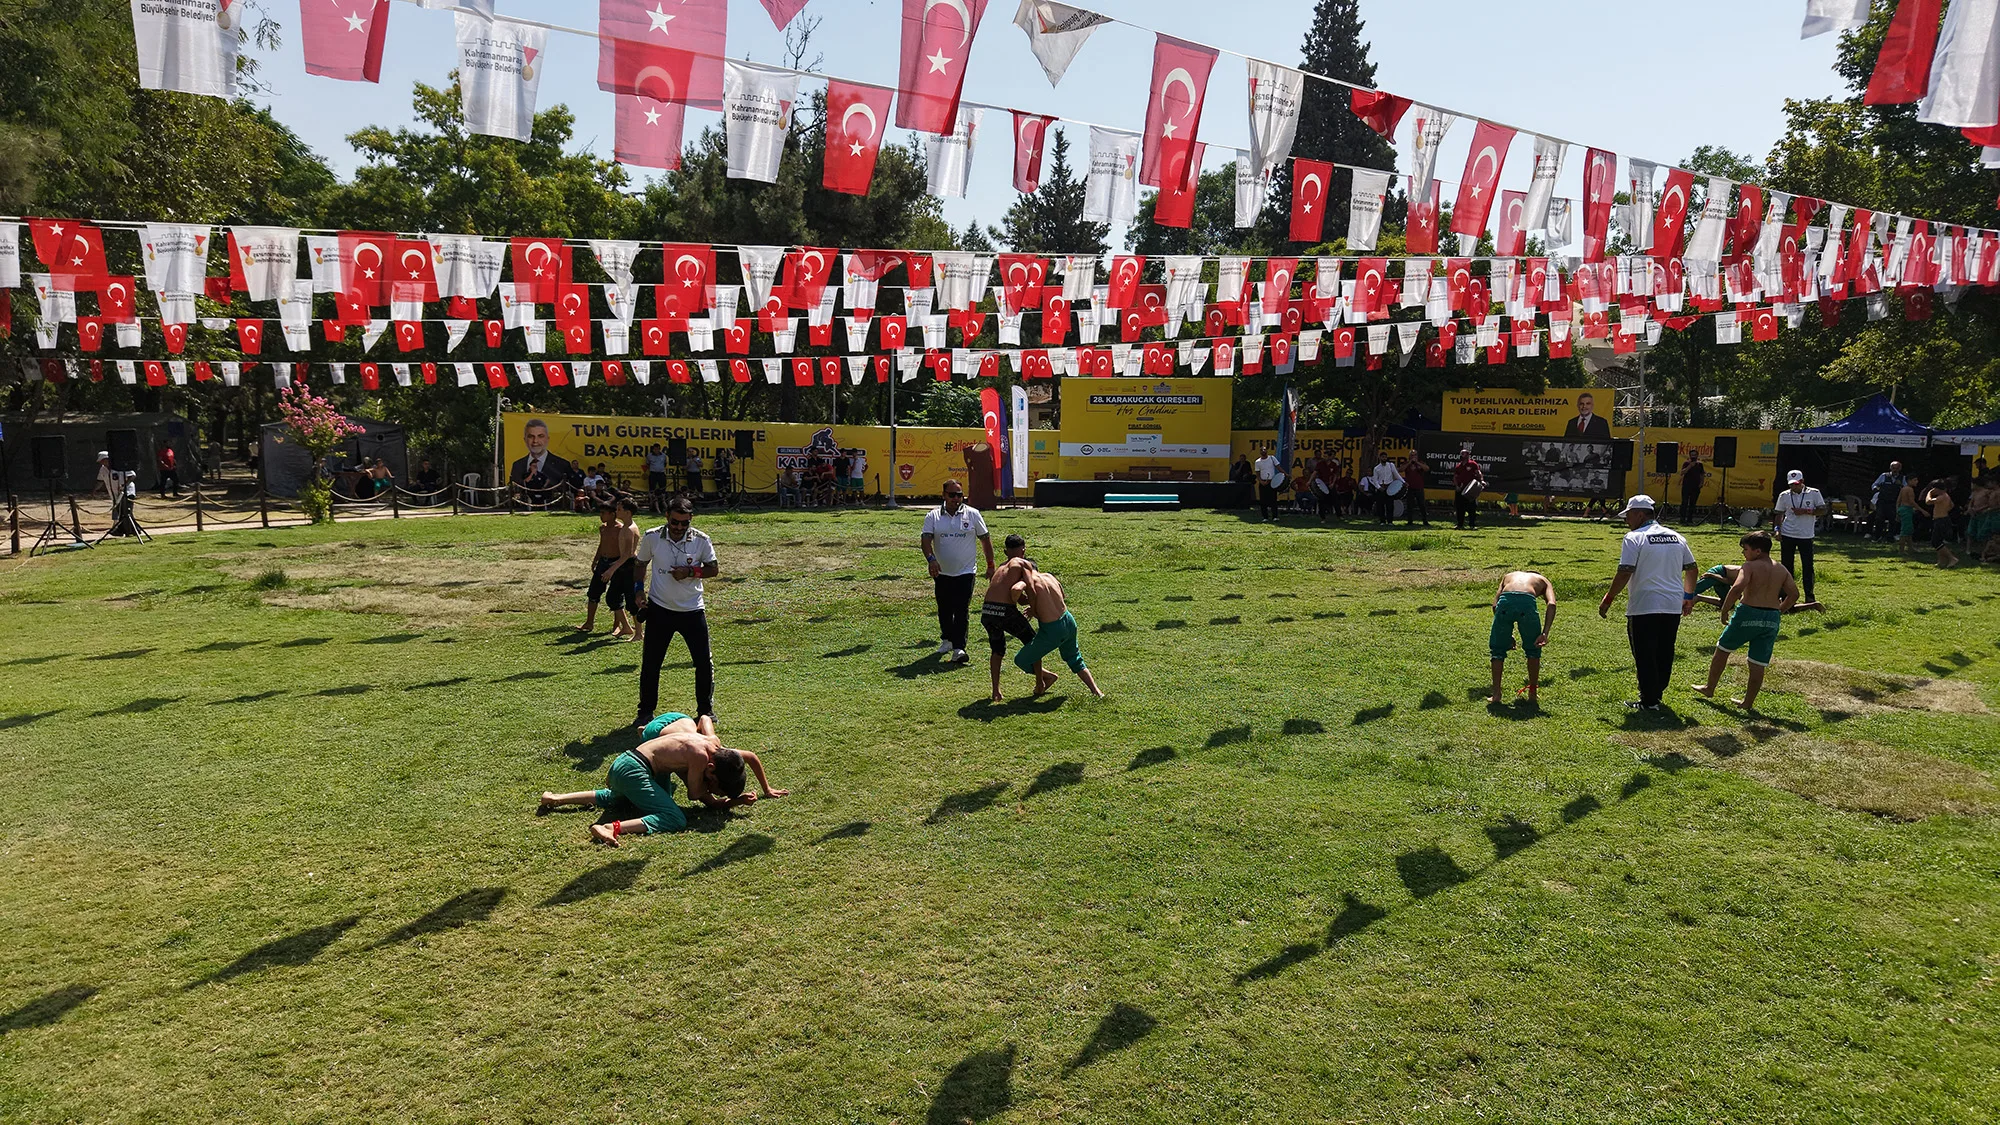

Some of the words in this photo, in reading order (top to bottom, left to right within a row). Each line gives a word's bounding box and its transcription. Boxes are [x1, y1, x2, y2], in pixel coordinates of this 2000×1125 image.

[140, 4, 179, 17] Büyükşehir
[181, 8, 216, 22] Belediyesi
[464, 49, 522, 65] Kahramanmaraş
[731, 104, 780, 118] Kahramanmaraş
[1138, 405, 1178, 416] Geldiniz
[1460, 407, 1516, 416] BAŞARILAR
[1809, 435, 1849, 443] Kahramanmaraş
[1108, 472, 1114, 480] 3
[1147, 471, 1151, 480] 1
[1187, 471, 1193, 480] 2
